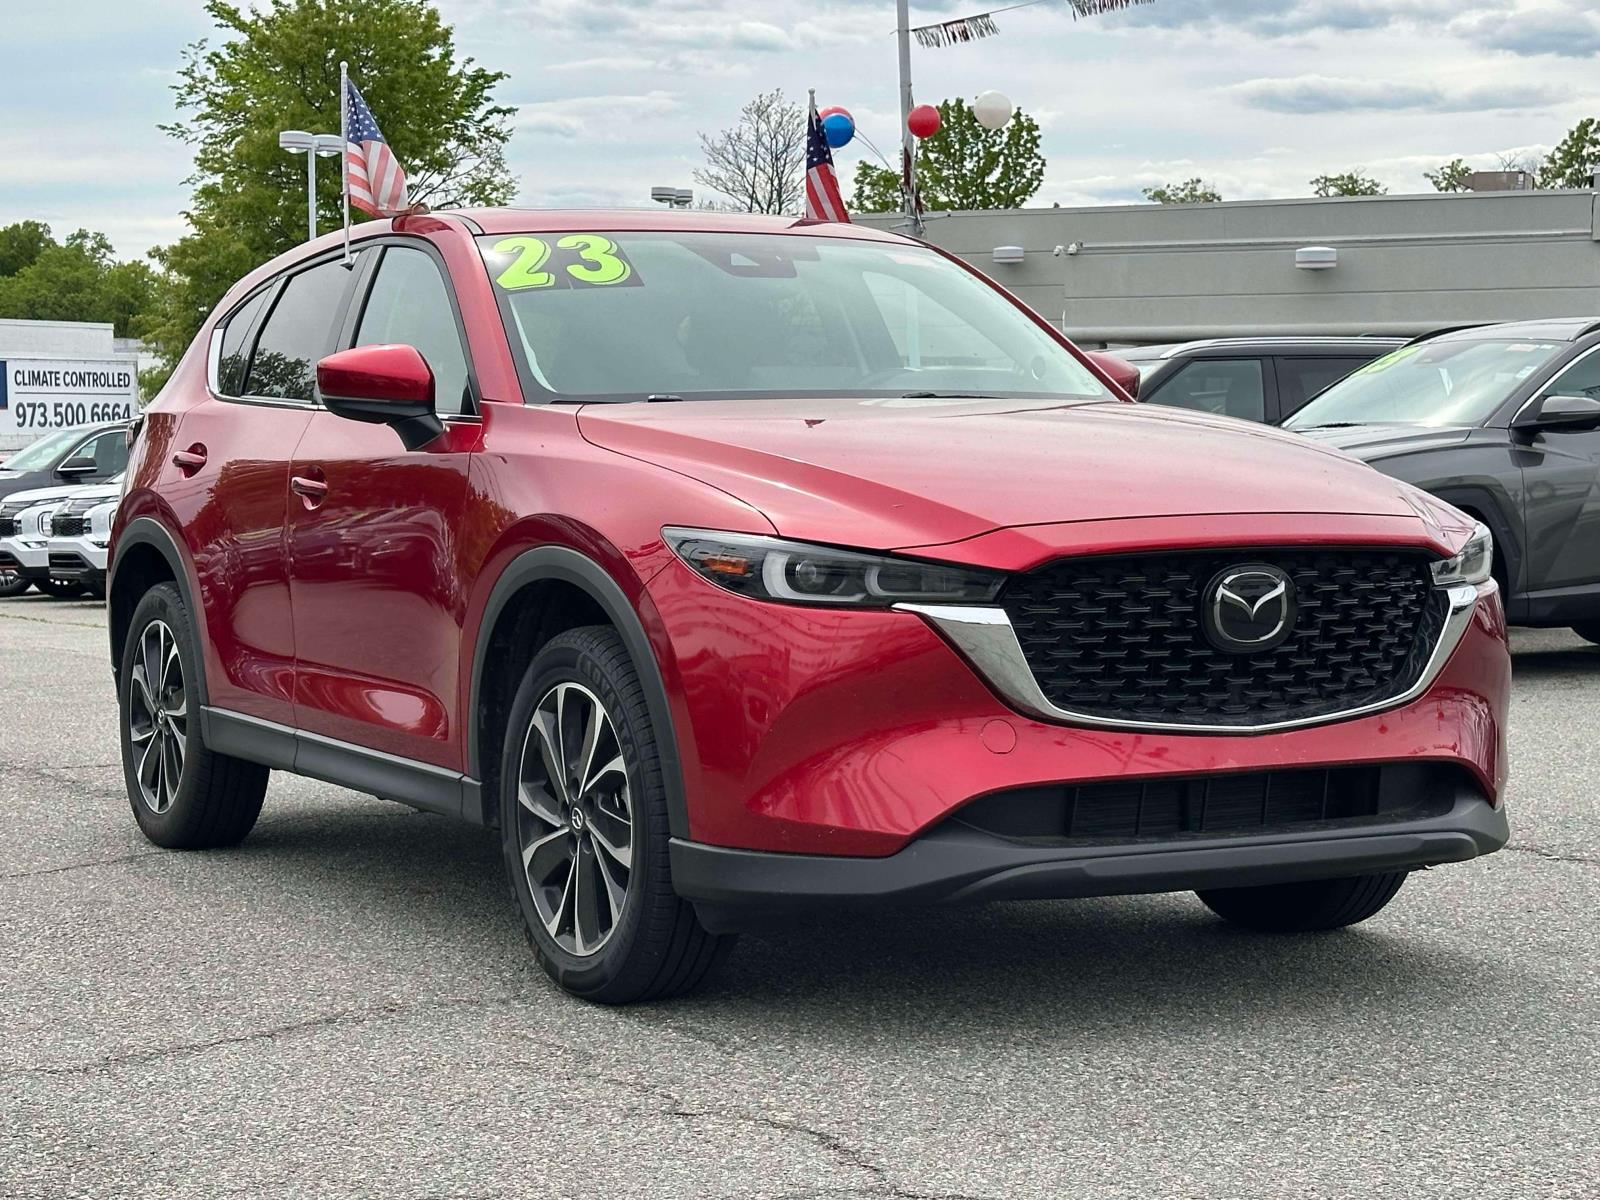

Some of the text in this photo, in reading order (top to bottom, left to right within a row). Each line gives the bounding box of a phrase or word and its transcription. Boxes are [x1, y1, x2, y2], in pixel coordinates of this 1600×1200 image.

[493, 234, 631, 290] 23
[14, 369, 131, 388] CLIMATE CONTROLLED
[15, 402, 131, 428] 973.5006664
